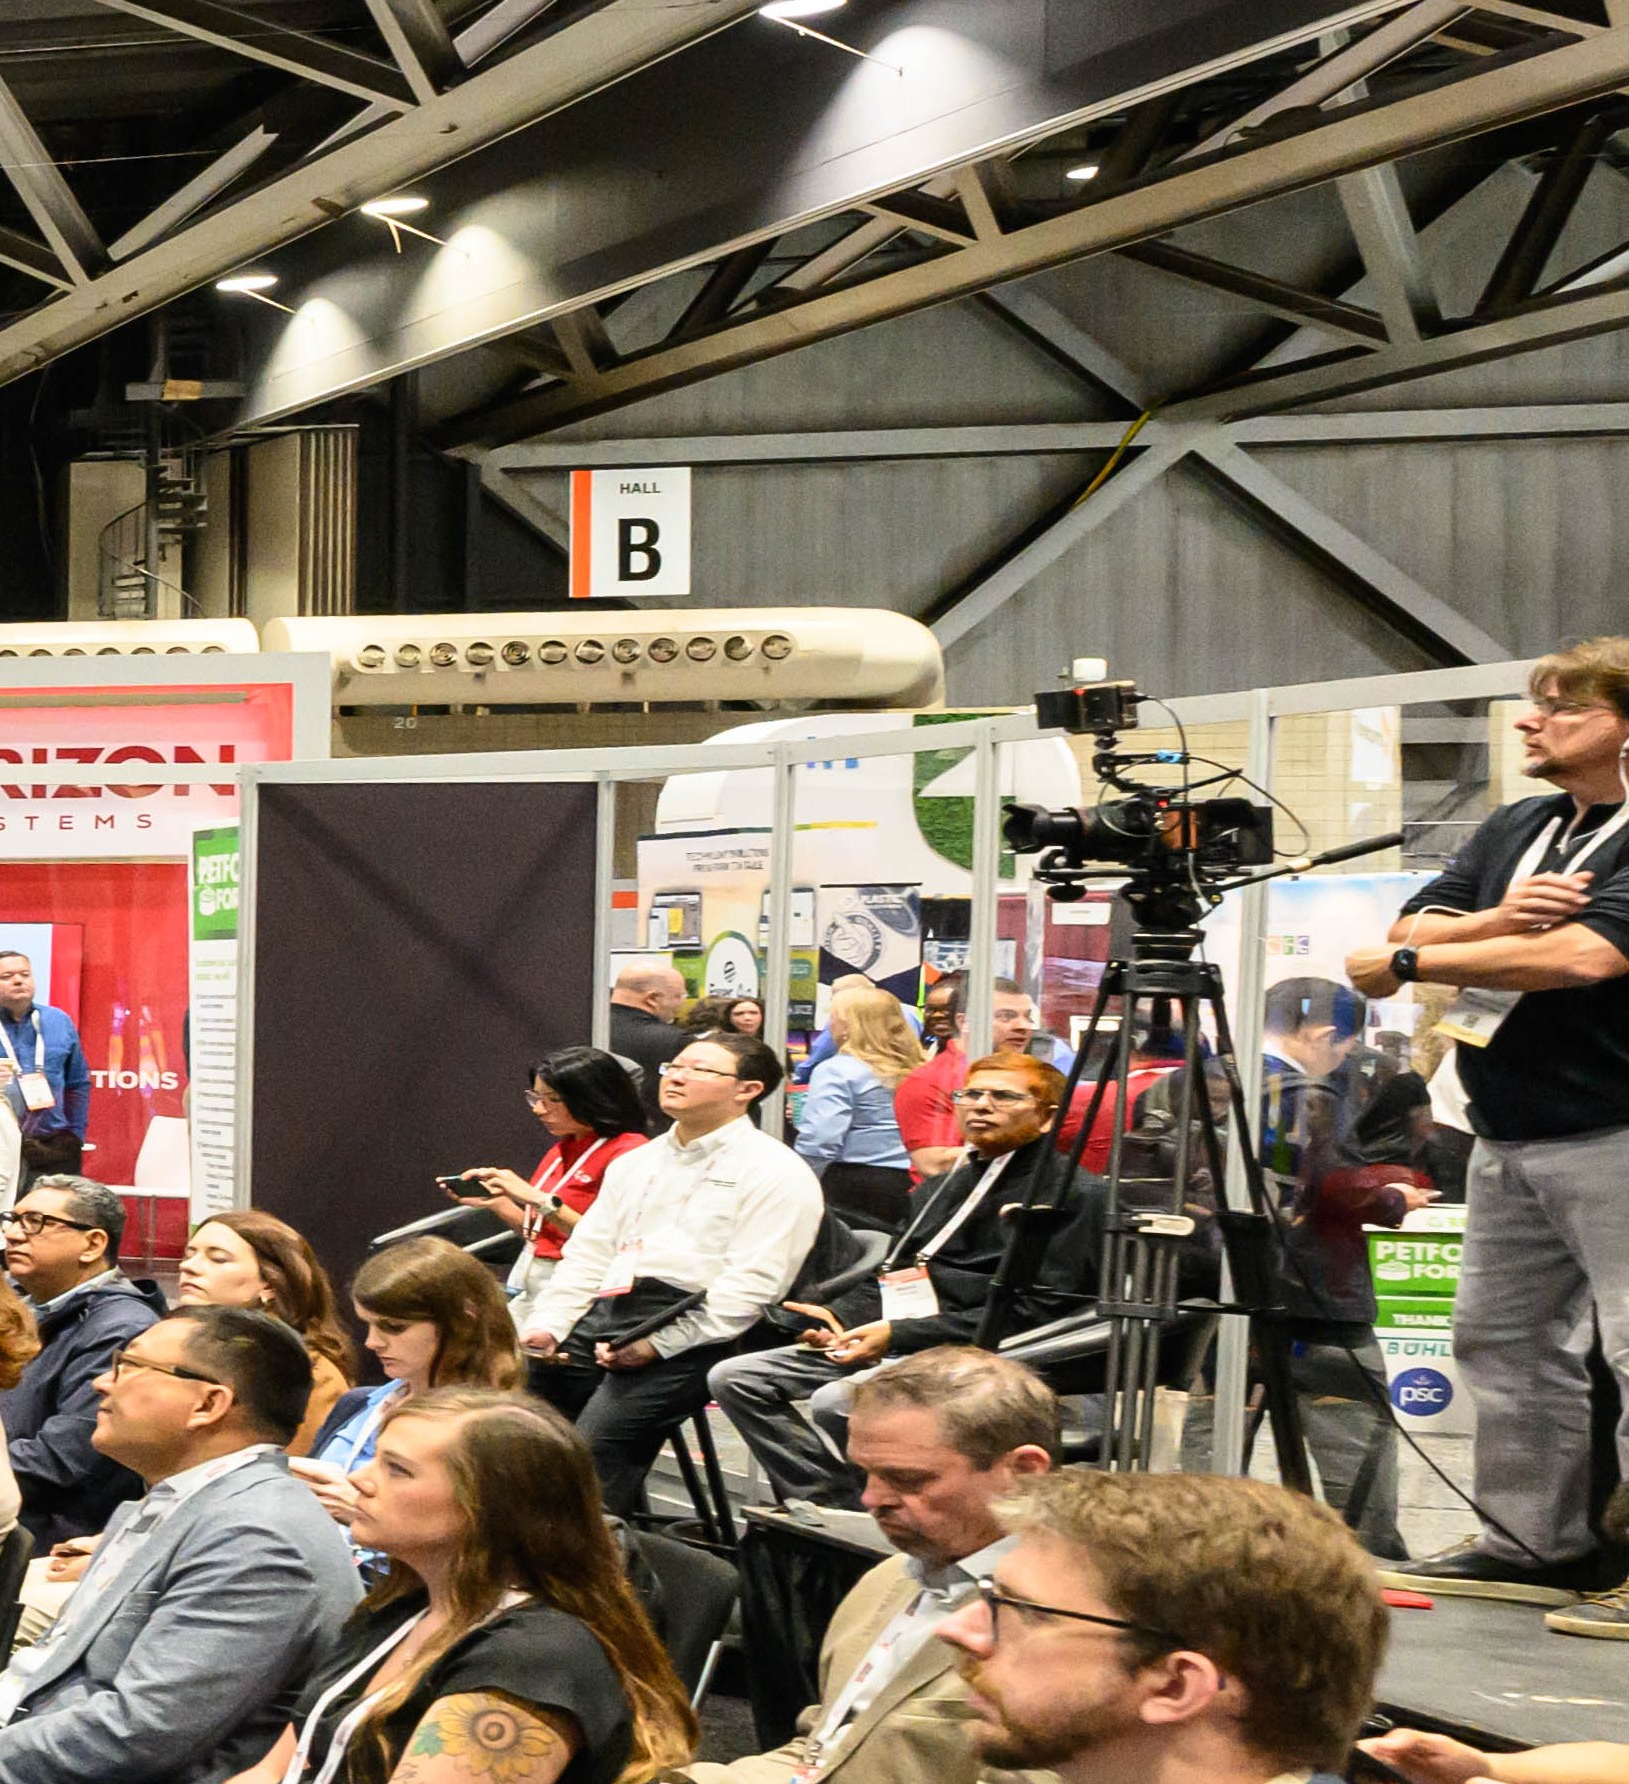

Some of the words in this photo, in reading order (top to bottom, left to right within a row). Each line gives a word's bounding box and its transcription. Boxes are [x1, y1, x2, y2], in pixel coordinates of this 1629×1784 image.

[619, 482, 661, 494] HALL
[618, 518, 662, 581] B
[1399, 1386, 1445, 1406] psc
